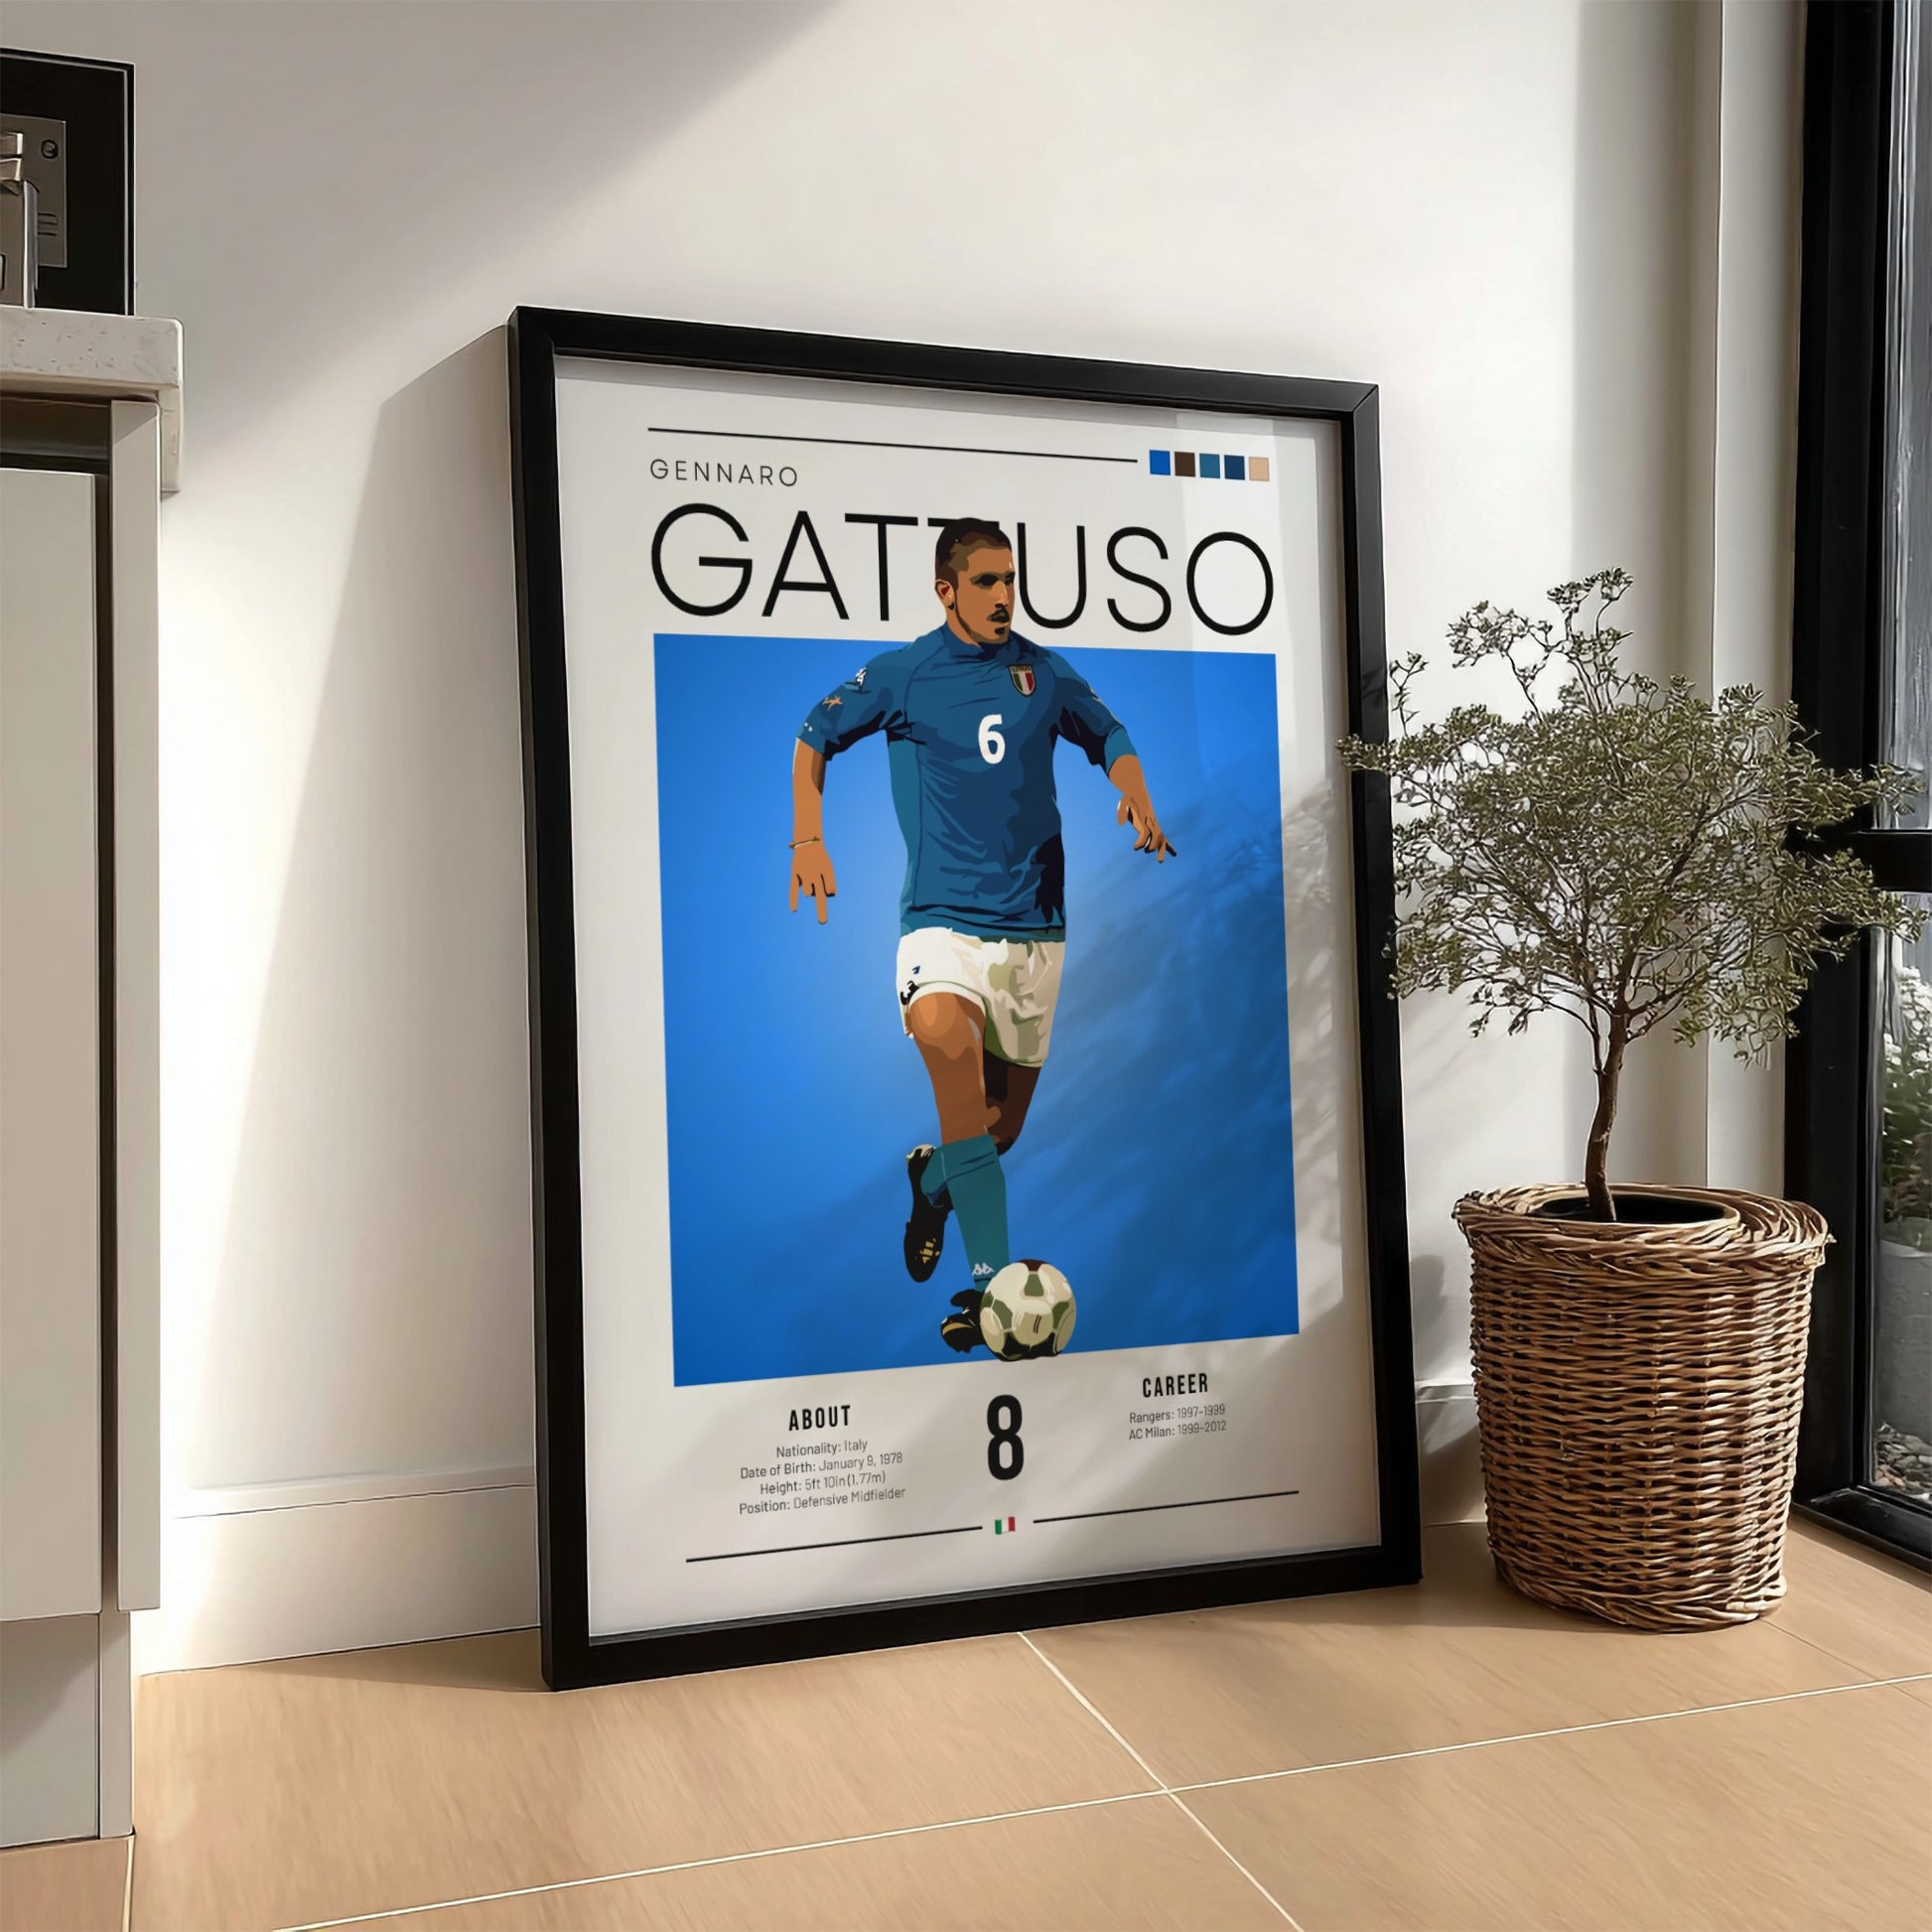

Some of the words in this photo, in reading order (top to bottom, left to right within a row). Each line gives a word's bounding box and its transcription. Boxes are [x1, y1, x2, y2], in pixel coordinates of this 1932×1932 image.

[649, 458, 799, 487] GENNARO
[651, 502, 1275, 636] GATUSO
[978, 714, 1006, 764] 6
[1142, 1373, 1208, 1398] CAREER
[788, 1405, 851, 1432] ABOUT
[1129, 1411, 1174, 1425] Rangers:
[1176, 1403, 1226, 1419] 1997-1999
[986, 1394, 1025, 1480] 8
[1129, 1429, 1143, 1441] AC
[1145, 1427, 1175, 1439] Milan:
[1177, 1420, 1227, 1436] 1999-2012
[776, 1442, 842, 1458] Nationality:
[844, 1439, 868, 1452] Italy
[741, 1466, 767, 1479] Date
[769, 1464, 781, 1476] of
[783, 1461, 816, 1474] Birth:
[819, 1457, 865, 1471] January
[867, 1454, 877, 1467] 9,
[880, 1451, 903, 1465] 1978
[759, 1480, 802, 1496] Height:
[805, 1478, 821, 1490] 5ft
[739, 1500, 791, 1515] Position:
[794, 1493, 849, 1509] Defensive
[851, 1487, 906, 1503] Midfielder
